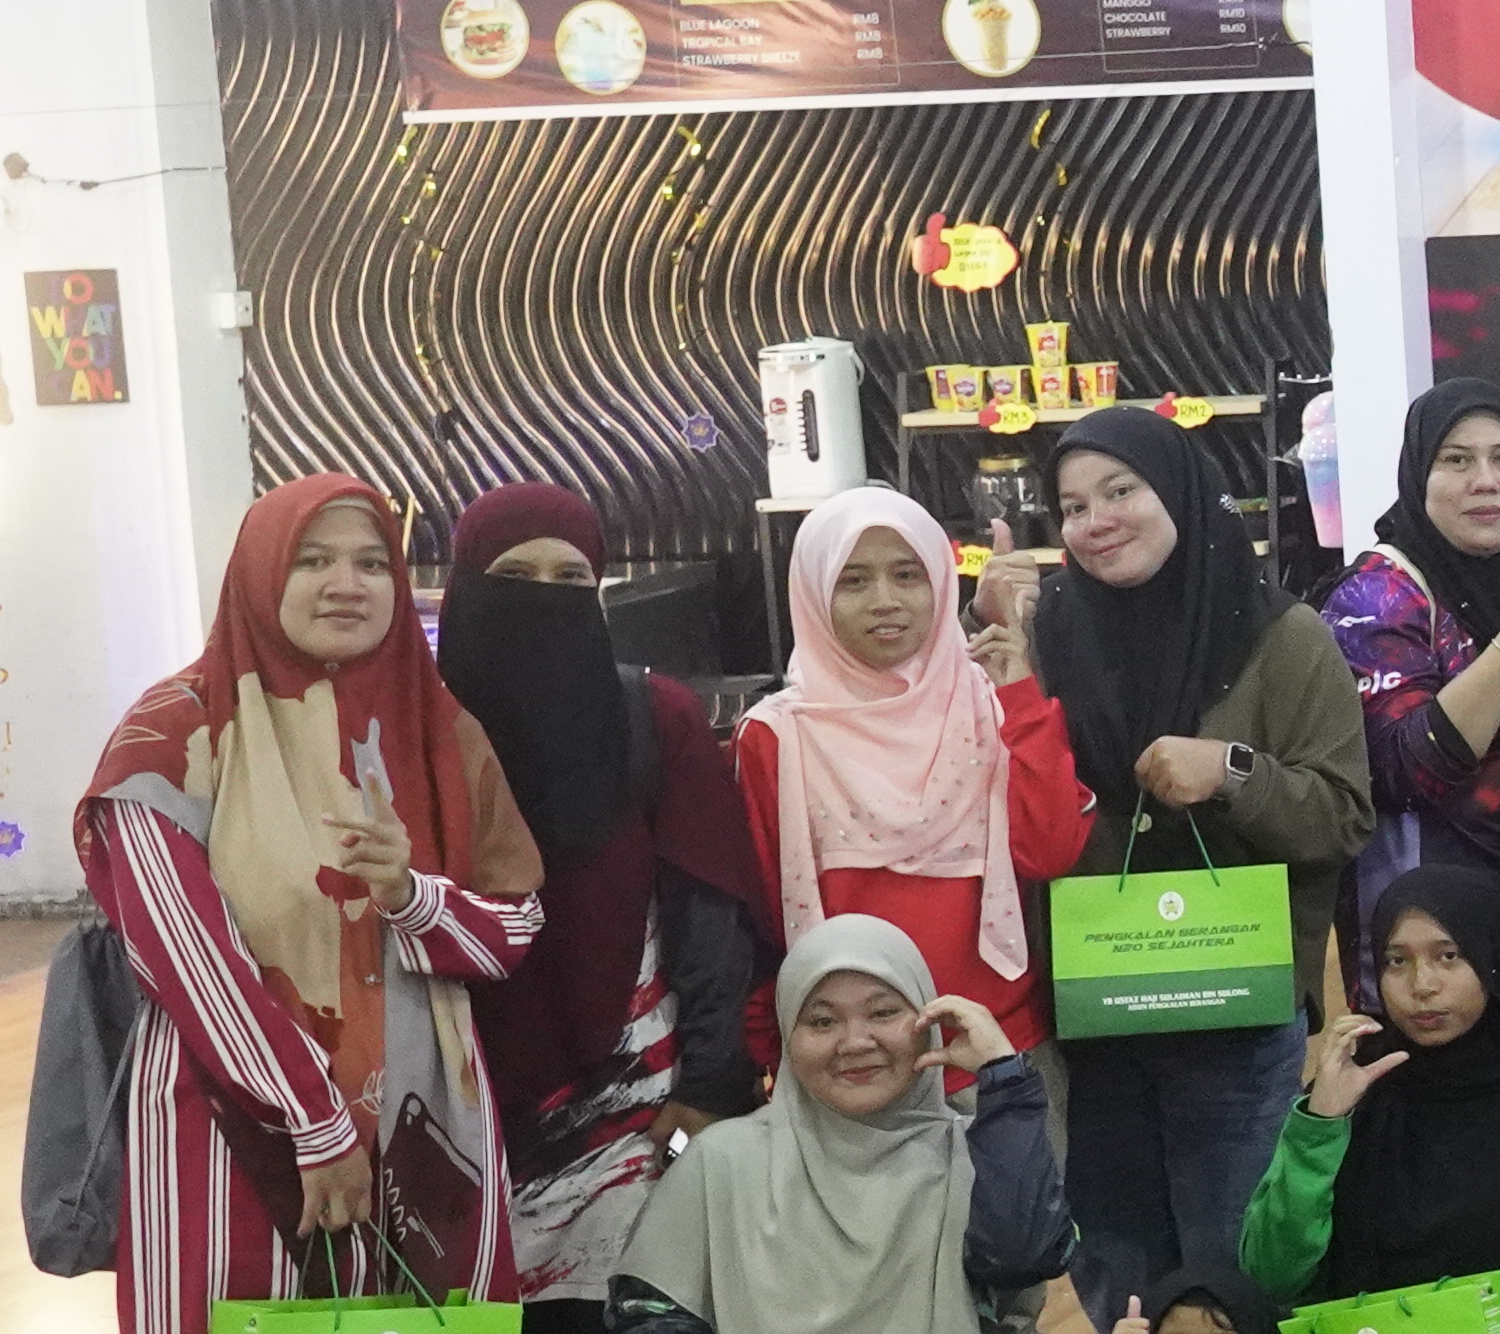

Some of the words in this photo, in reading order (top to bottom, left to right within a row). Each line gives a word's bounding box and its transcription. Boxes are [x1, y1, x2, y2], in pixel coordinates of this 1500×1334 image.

[30, 303, 116, 338] WAT
[1003, 410, 1029, 423] RM3
[1180, 405, 1208, 418] RM2
